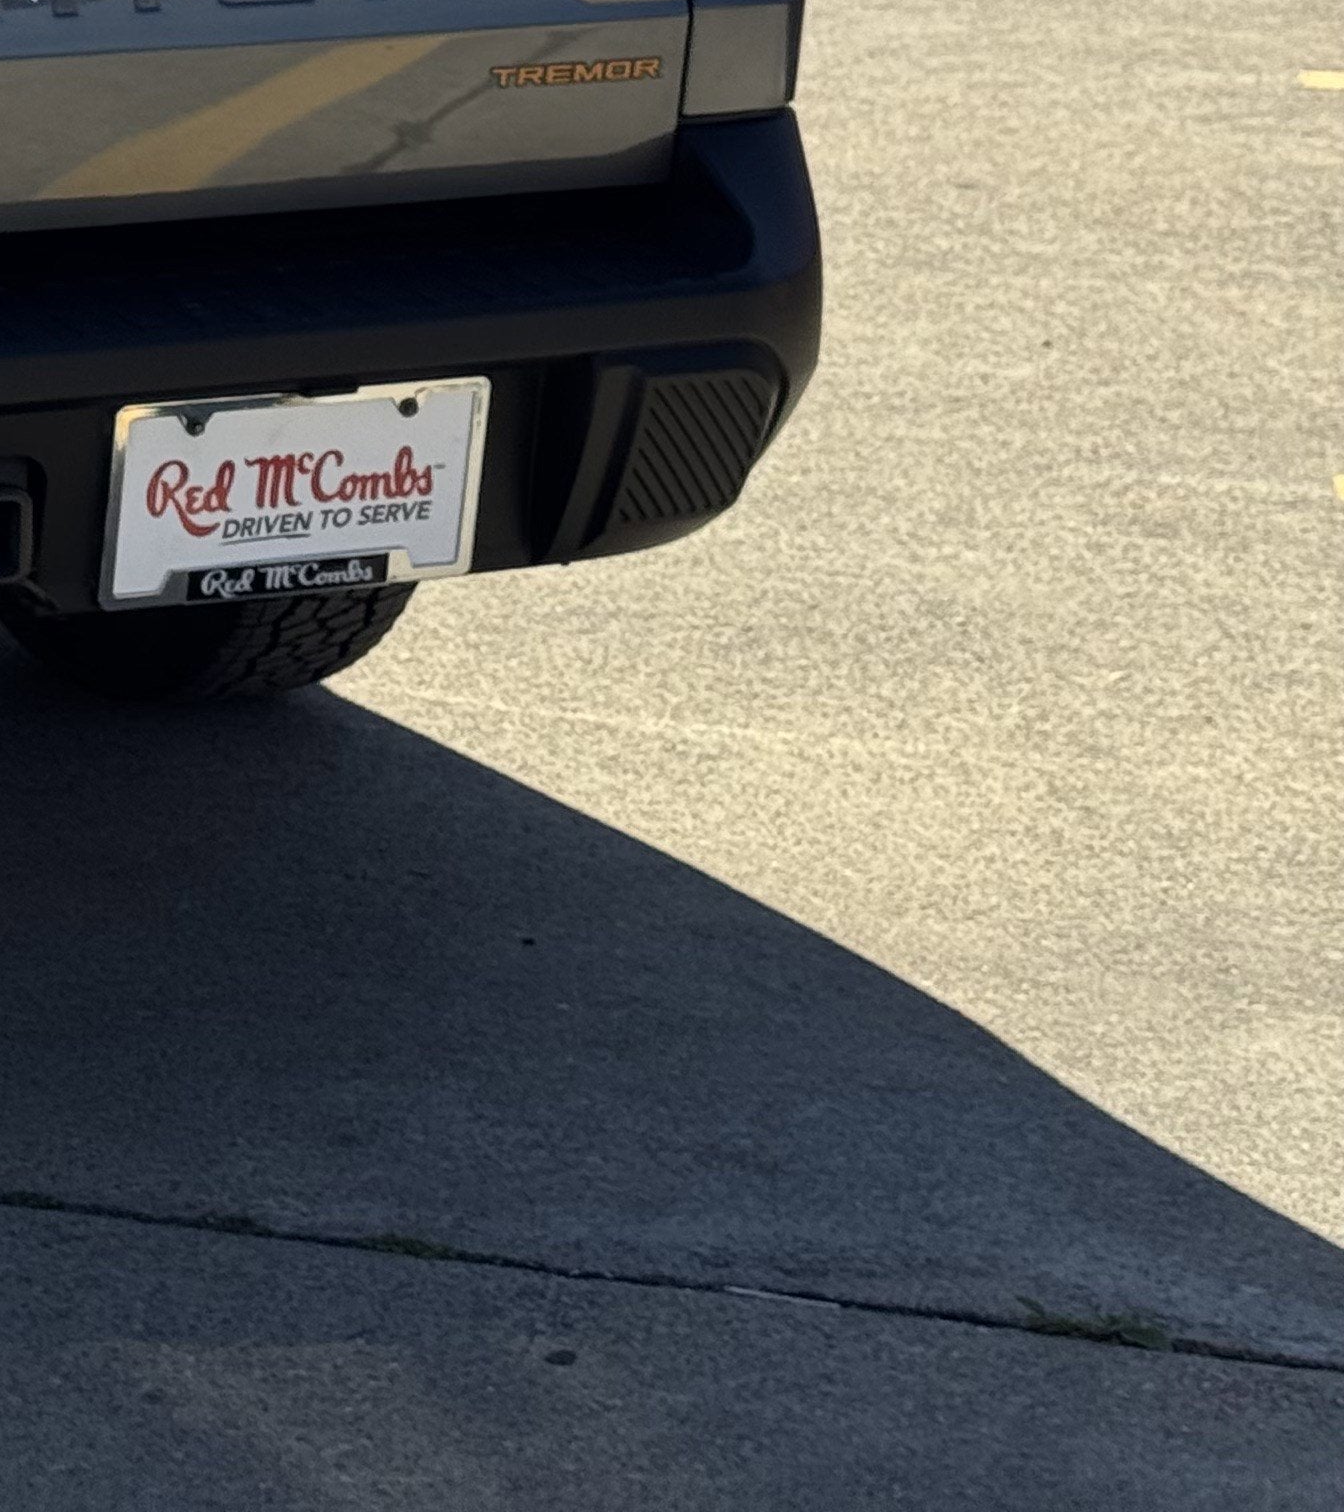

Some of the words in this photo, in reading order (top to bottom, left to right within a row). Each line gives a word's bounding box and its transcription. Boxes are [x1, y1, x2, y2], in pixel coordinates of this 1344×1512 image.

[490, 56, 662, 88] TREMOR
[146, 459, 236, 537] Red
[221, 510, 314, 539] DRIVEN
[319, 506, 355, 530] TO
[358, 499, 433, 527] SERVE
[200, 567, 255, 600] Red
